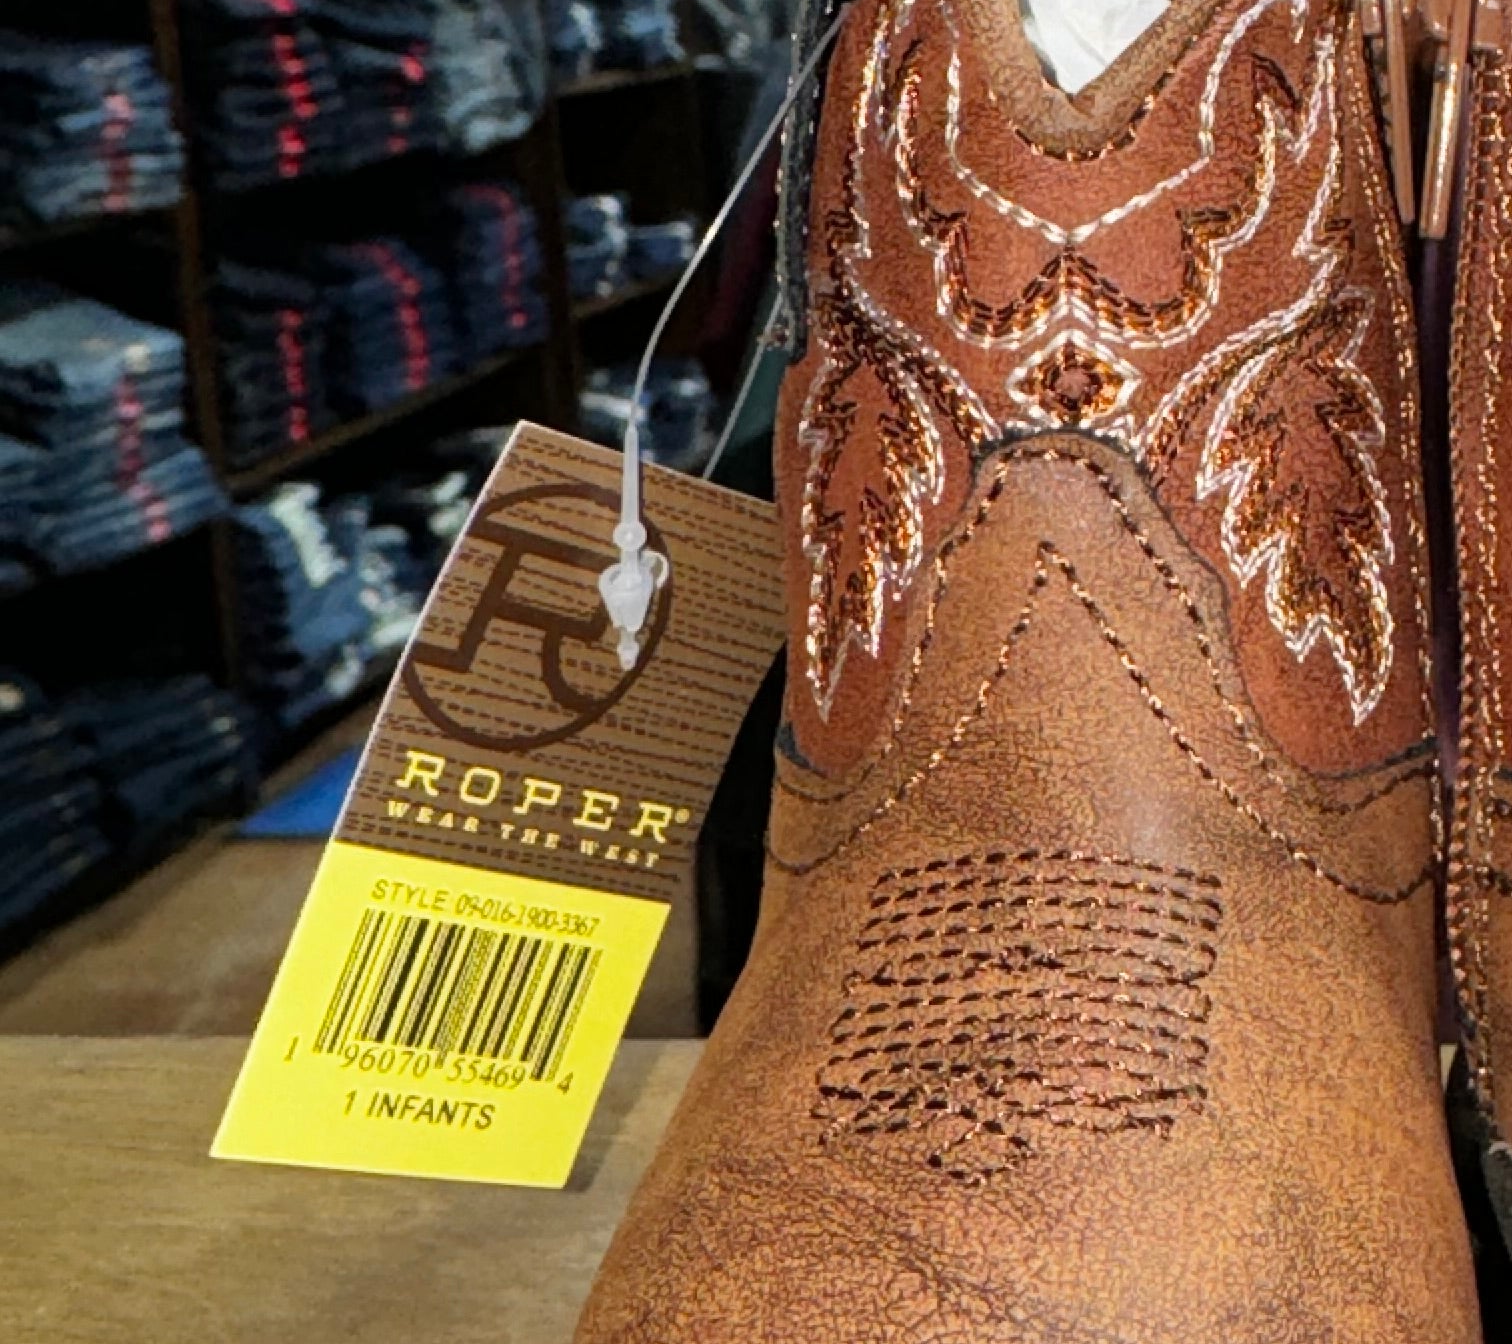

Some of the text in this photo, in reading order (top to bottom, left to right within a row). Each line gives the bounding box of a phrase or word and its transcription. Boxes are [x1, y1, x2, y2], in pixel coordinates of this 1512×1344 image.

[396, 749, 674, 844] ROPER
[387, 800, 660, 868] WEAR THE WEST
[371, 878, 450, 912] STYLE
[340, 1043, 431, 1079] 96070
[446, 1057, 527, 1090] 55469
[556, 1071, 574, 1095] 4
[343, 1089, 496, 1131] 1 INFANTS
